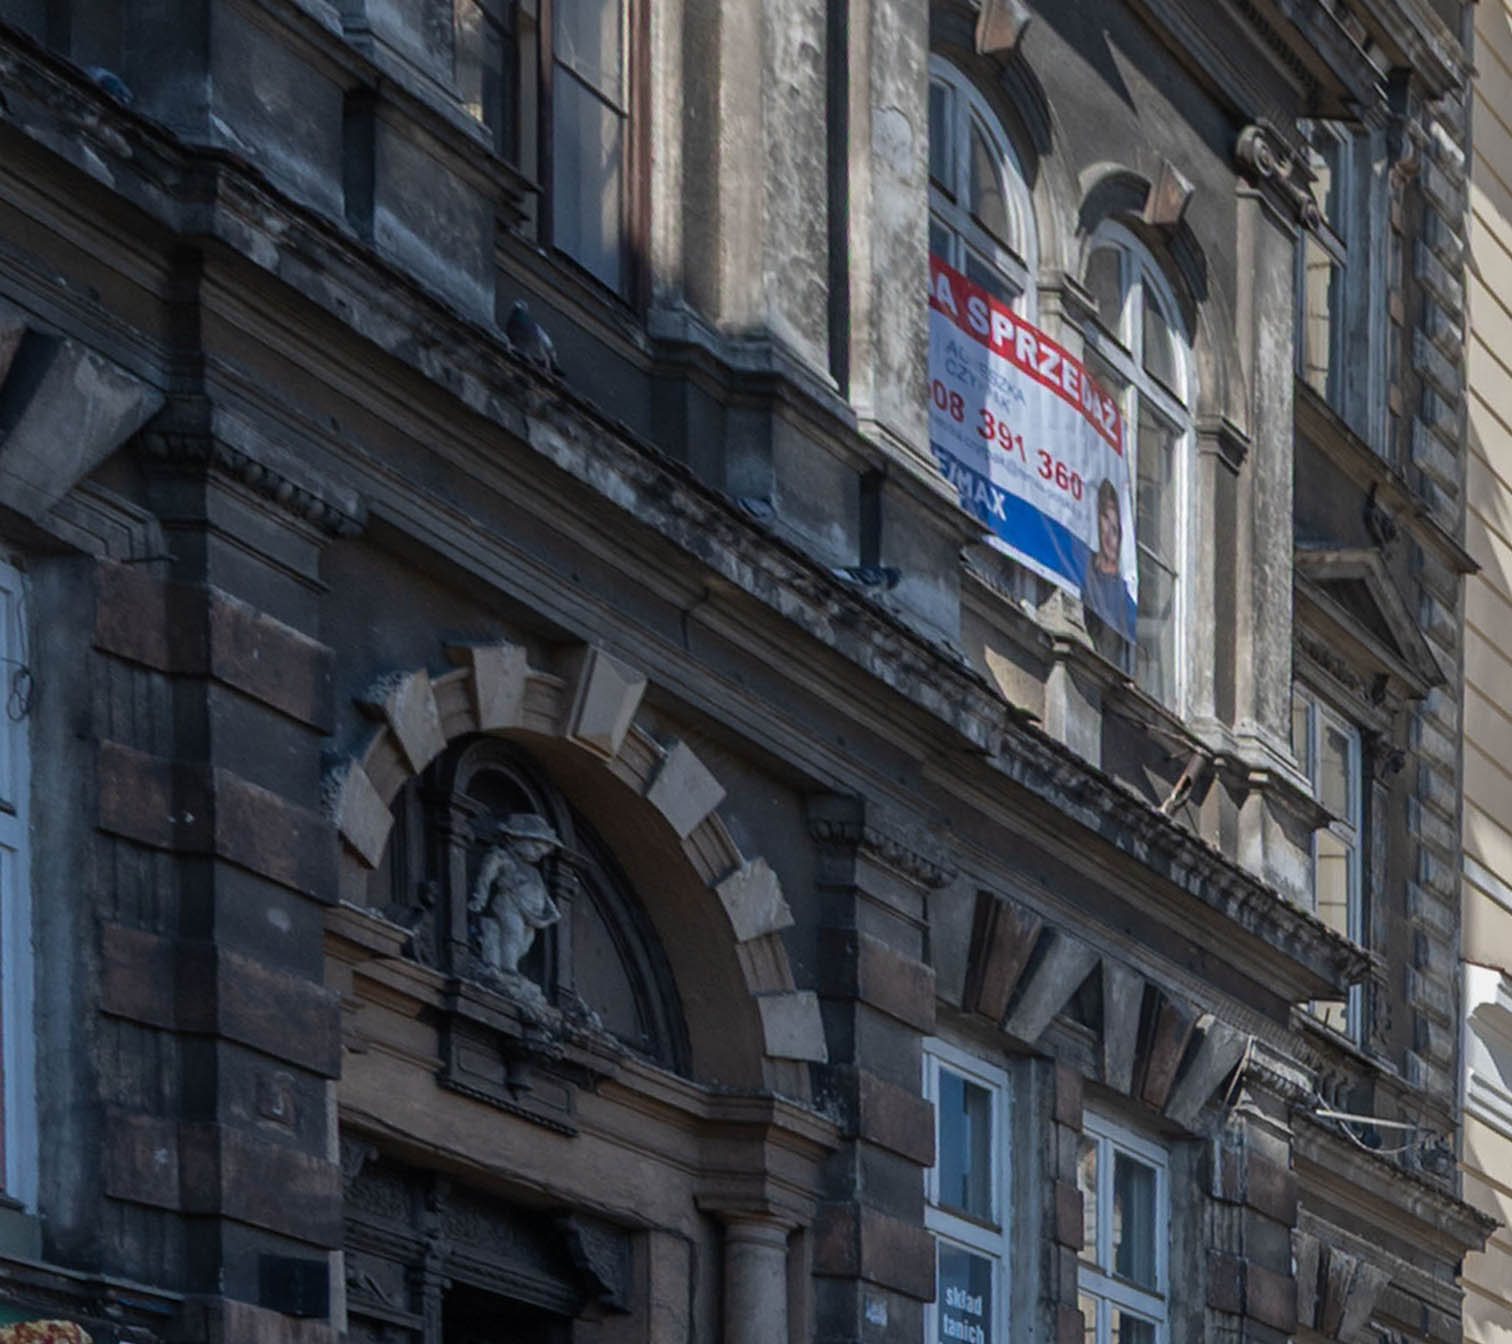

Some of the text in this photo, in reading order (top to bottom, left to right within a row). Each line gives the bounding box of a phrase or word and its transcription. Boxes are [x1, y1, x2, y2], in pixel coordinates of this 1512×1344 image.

[929, 274, 958, 316] A
[967, 295, 1117, 439] SPRZEDAŻ
[929, 378, 965, 423] 08
[977, 408, 1027, 464] 391
[1037, 449, 1083, 501] 360
[945, 1286, 983, 1316] skład
